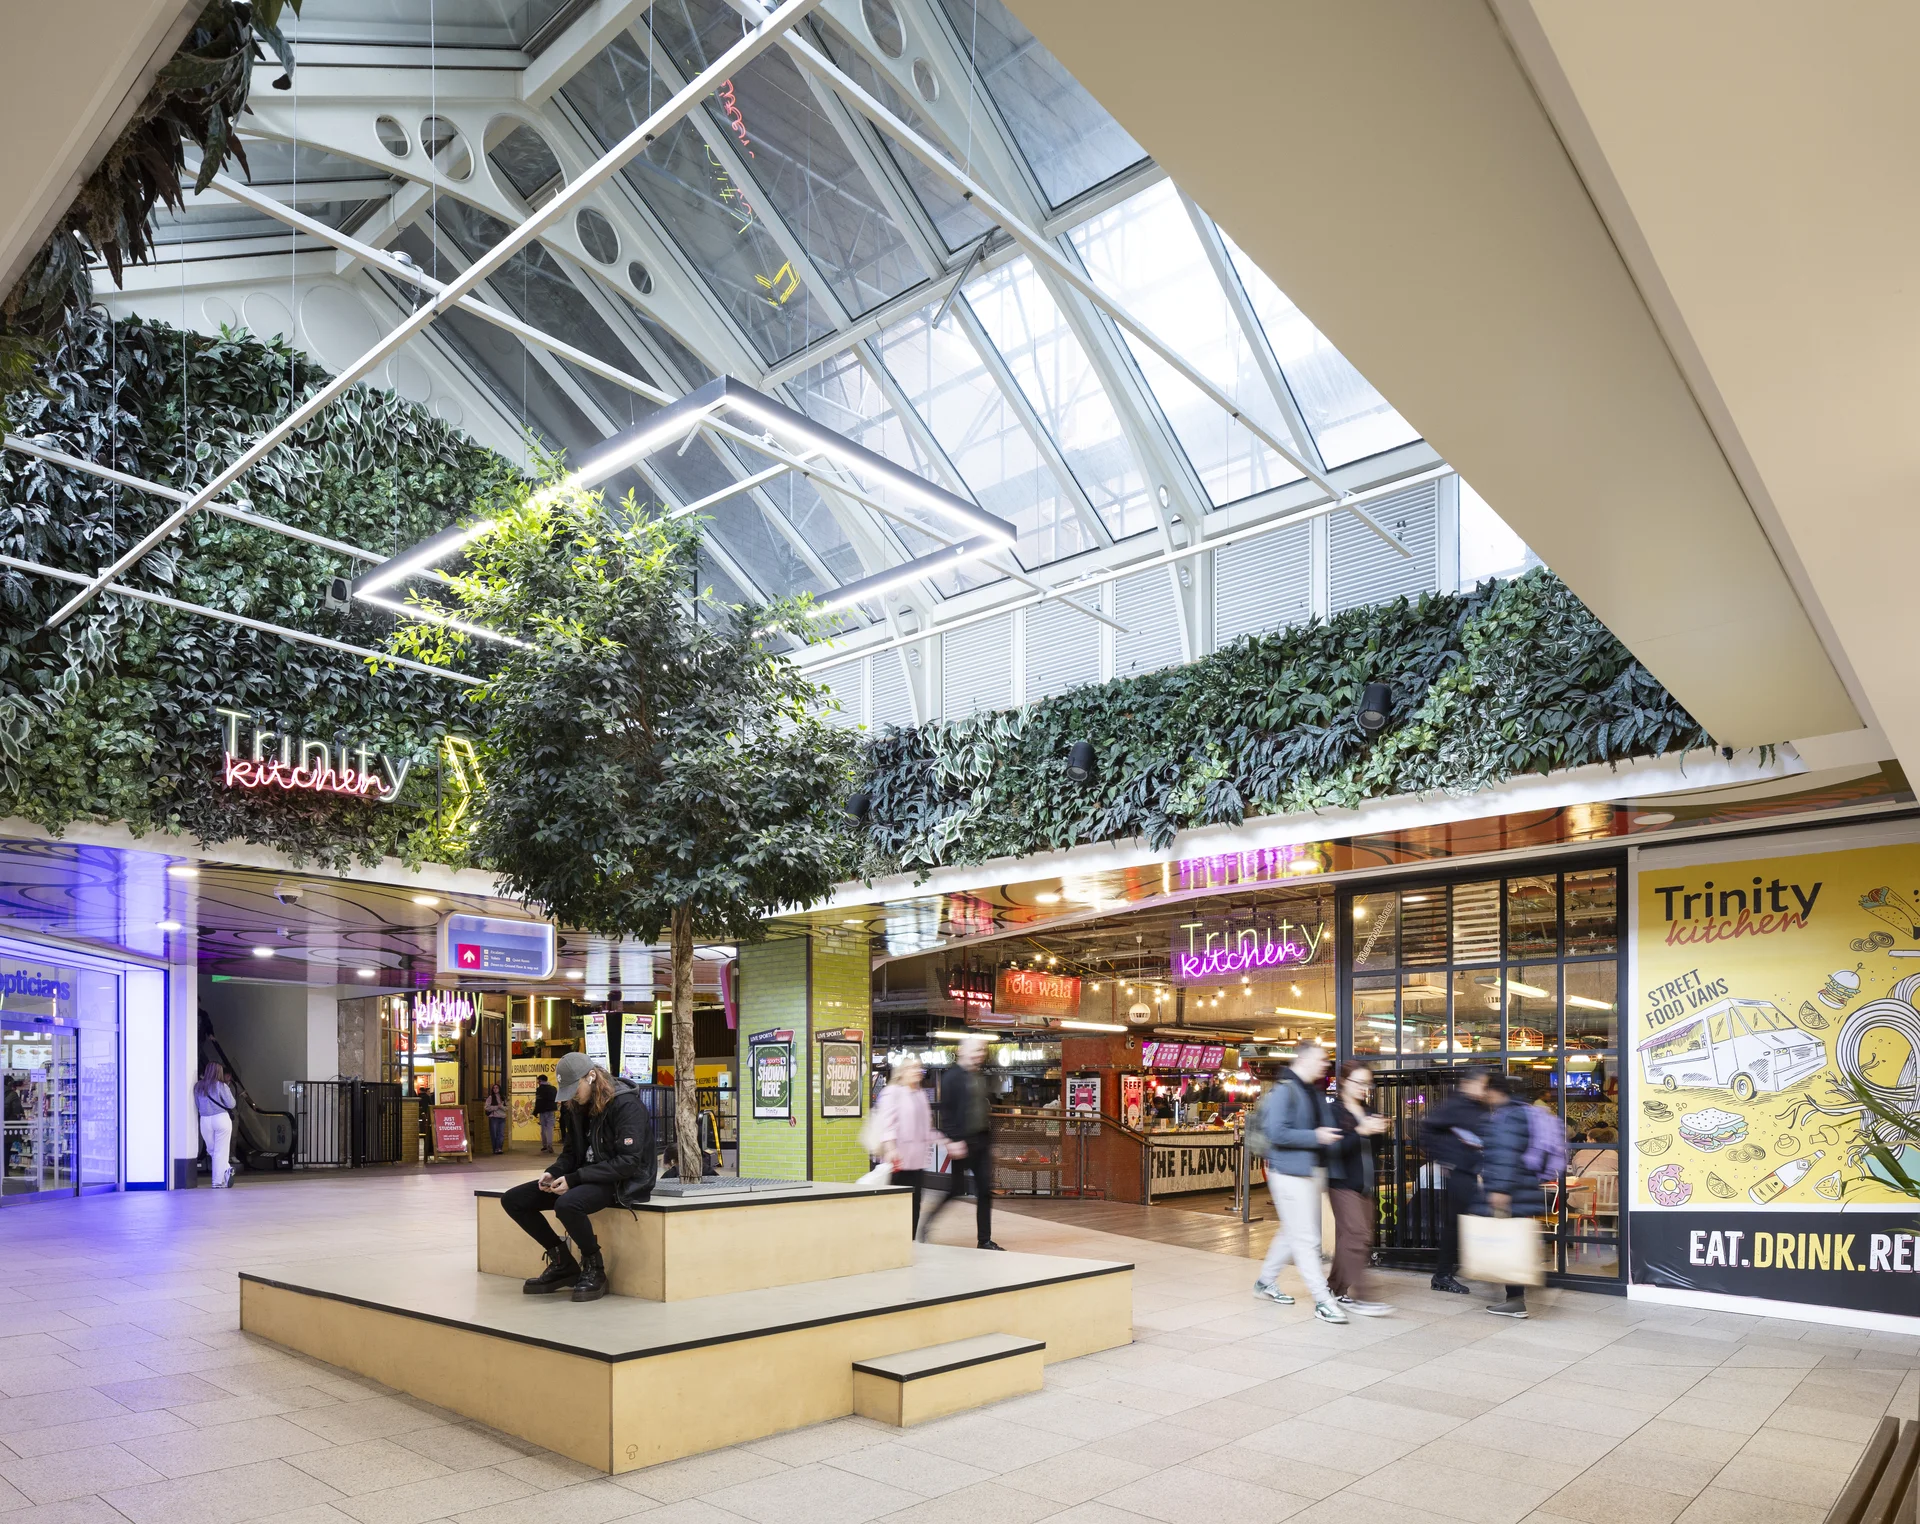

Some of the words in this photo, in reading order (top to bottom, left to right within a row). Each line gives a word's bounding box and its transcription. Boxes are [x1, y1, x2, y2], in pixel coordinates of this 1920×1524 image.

[215, 707, 412, 803] Trinity
[225, 751, 391, 794] kitchen
[1654, 876, 1823, 924] Trinity
[1180, 918, 1324, 964] Trinity
[1665, 908, 1808, 947] kitchen
[1181, 939, 1305, 978] kitchen
[1645, 1000, 1685, 1029] FOOD
[1686, 977, 1729, 1009] VANS
[1648, 968, 1702, 1008] STREET
[758, 1031, 773, 1040] SPORTS
[440, 1077, 455, 1086] Trinity
[514, 1065, 528, 1073] BRAND
[529, 1064, 549, 1073] COMING
[758, 1065, 786, 1081] SHOWN
[826, 1064, 857, 1080] SHOWN
[1124, 1081, 1141, 1090] BEEF
[761, 1081, 781, 1097] HERE
[830, 1081, 851, 1096] HERE
[1180, 1148, 1237, 1177] FLAVOU
[1689, 1230, 1750, 1268] EAT.
[1754, 1231, 1867, 1272] DRINK.
